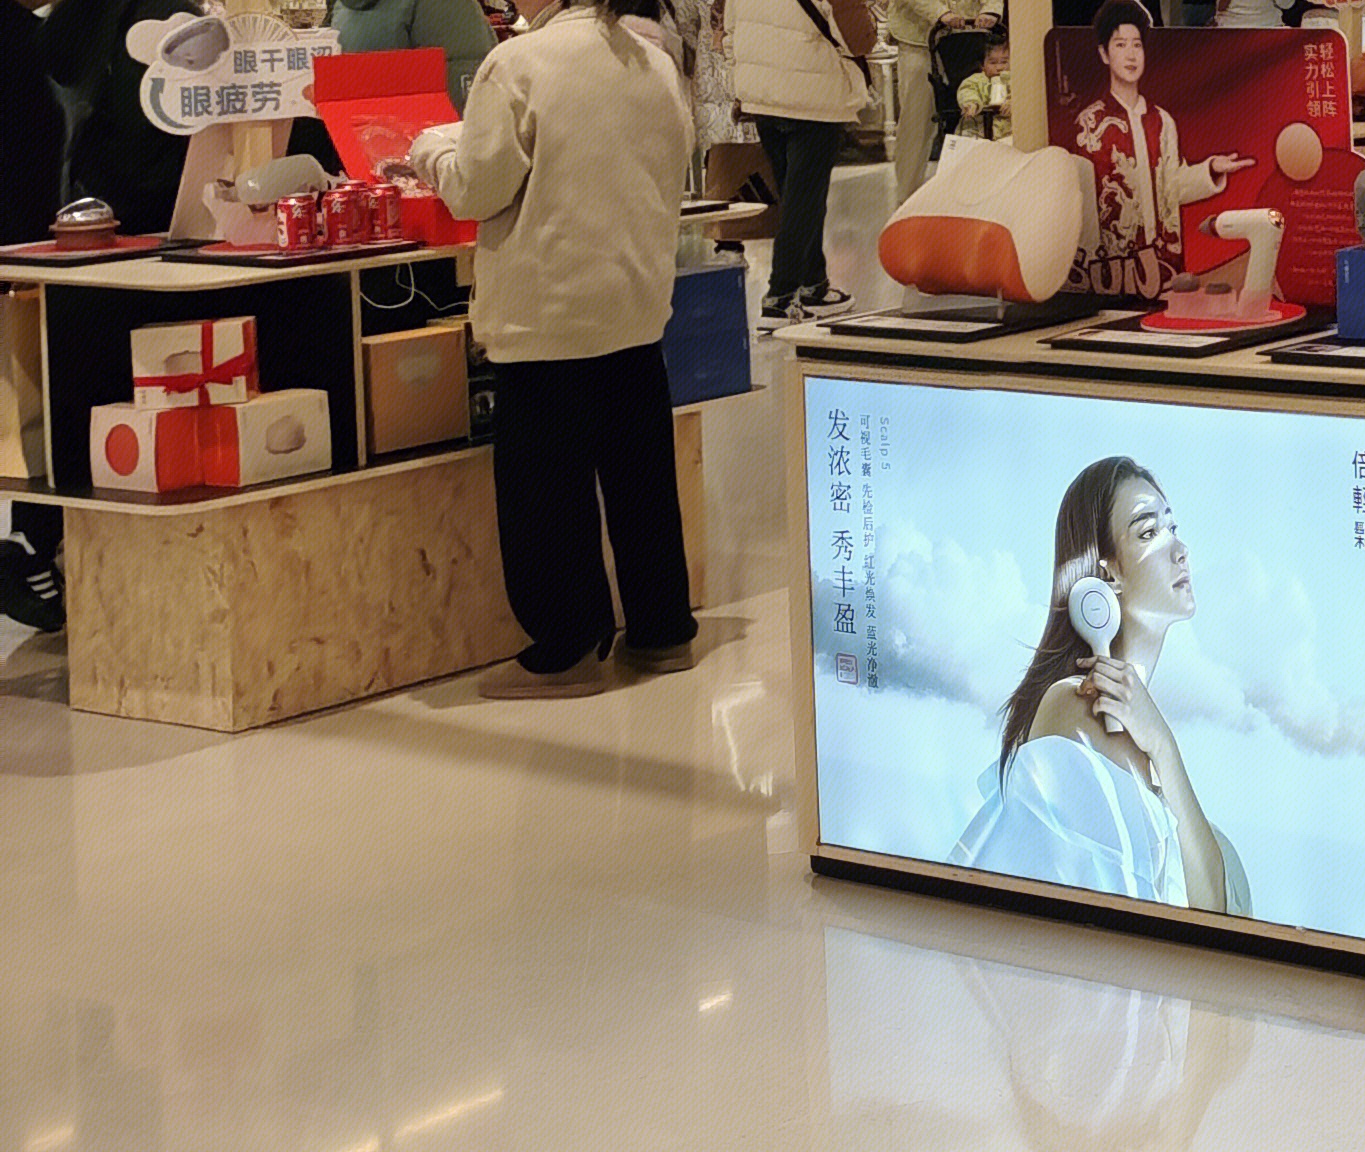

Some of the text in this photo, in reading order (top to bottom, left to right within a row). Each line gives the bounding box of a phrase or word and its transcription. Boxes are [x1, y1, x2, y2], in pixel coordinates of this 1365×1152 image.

[180, 81, 283, 118] 眼疲劳
[1319, 41, 1337, 118] 轻松上阵
[827, 408, 852, 513] 发浓密
[879, 416, 891, 457] Scalp
[831, 529, 857, 635] 秀丰盈
